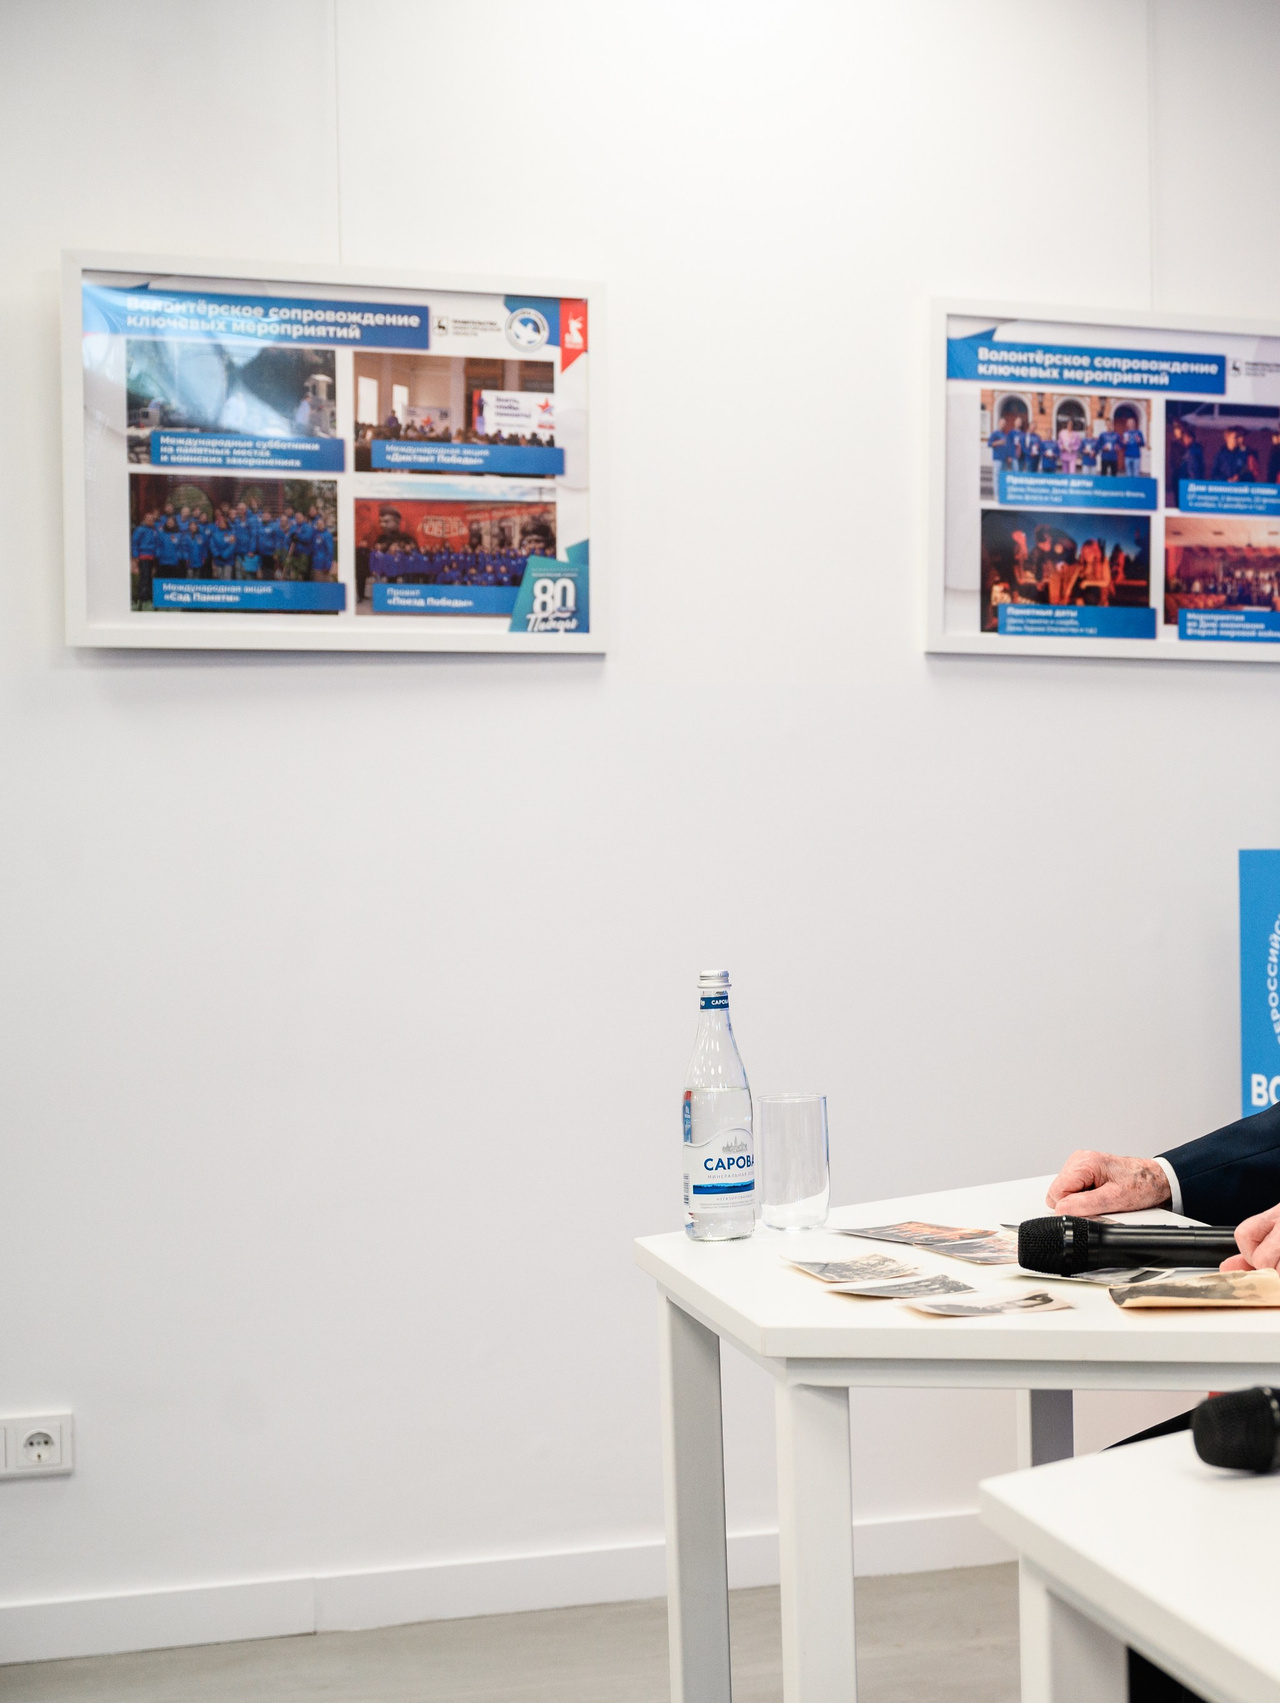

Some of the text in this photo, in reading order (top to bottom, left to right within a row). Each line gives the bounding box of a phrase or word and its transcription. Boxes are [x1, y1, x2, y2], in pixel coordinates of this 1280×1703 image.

[126, 297, 420, 328] Волонтёрское сопровождение
[126, 315, 361, 339] ключевых мероприятий
[978, 347, 1219, 375] Волонтёрское сопровождение
[978, 363, 1169, 385] ключевых мероприятий
[532, 578, 576, 617] 80
